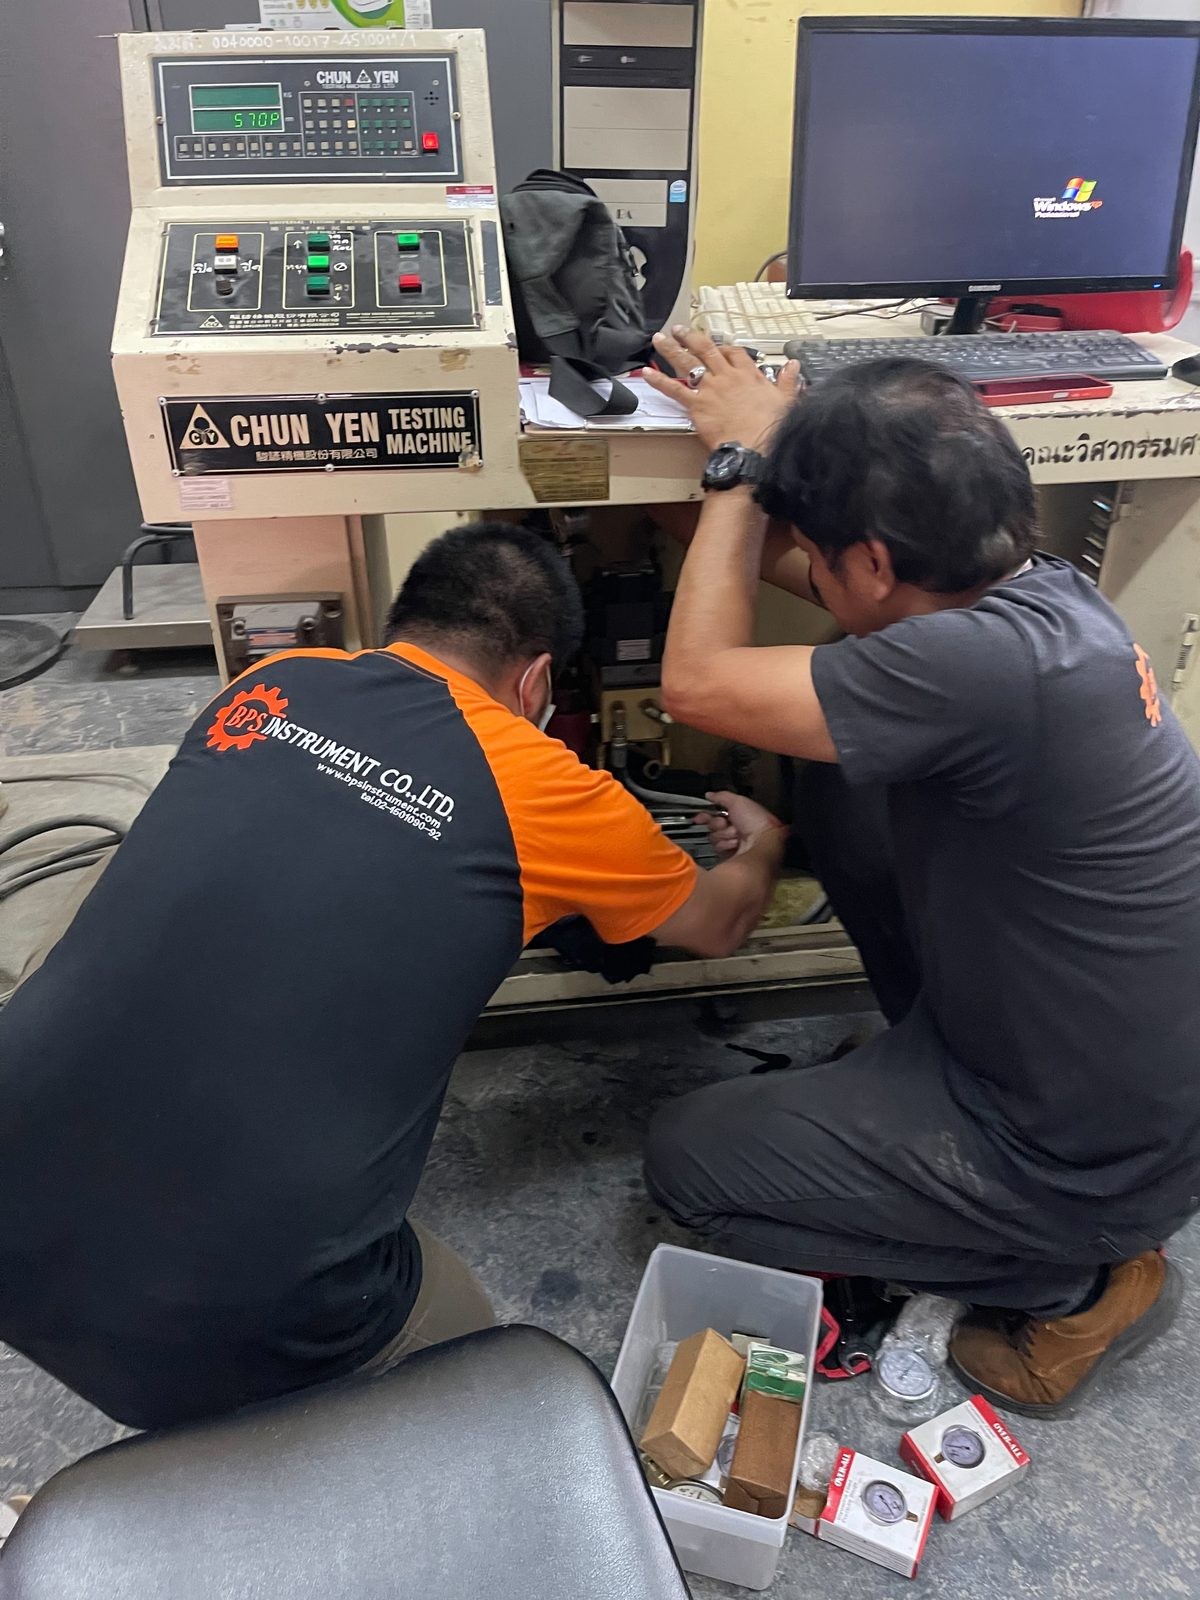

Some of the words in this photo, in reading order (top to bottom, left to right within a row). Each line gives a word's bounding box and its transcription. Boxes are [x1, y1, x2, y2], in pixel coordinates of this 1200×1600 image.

[316, 70, 351, 84] CHUN
[373, 70, 399, 83] YEN
[230, 414, 310, 447] CHUN
[325, 412, 381, 444] YEN
[388, 406, 465, 430] TESTING
[386, 431, 472, 455] MACHINE
[1022, 433, 1200, 466] คณะวิศวกรรมศ
[225, 705, 268, 733] BPS
[260, 716, 382, 777] INSTRUMENT
